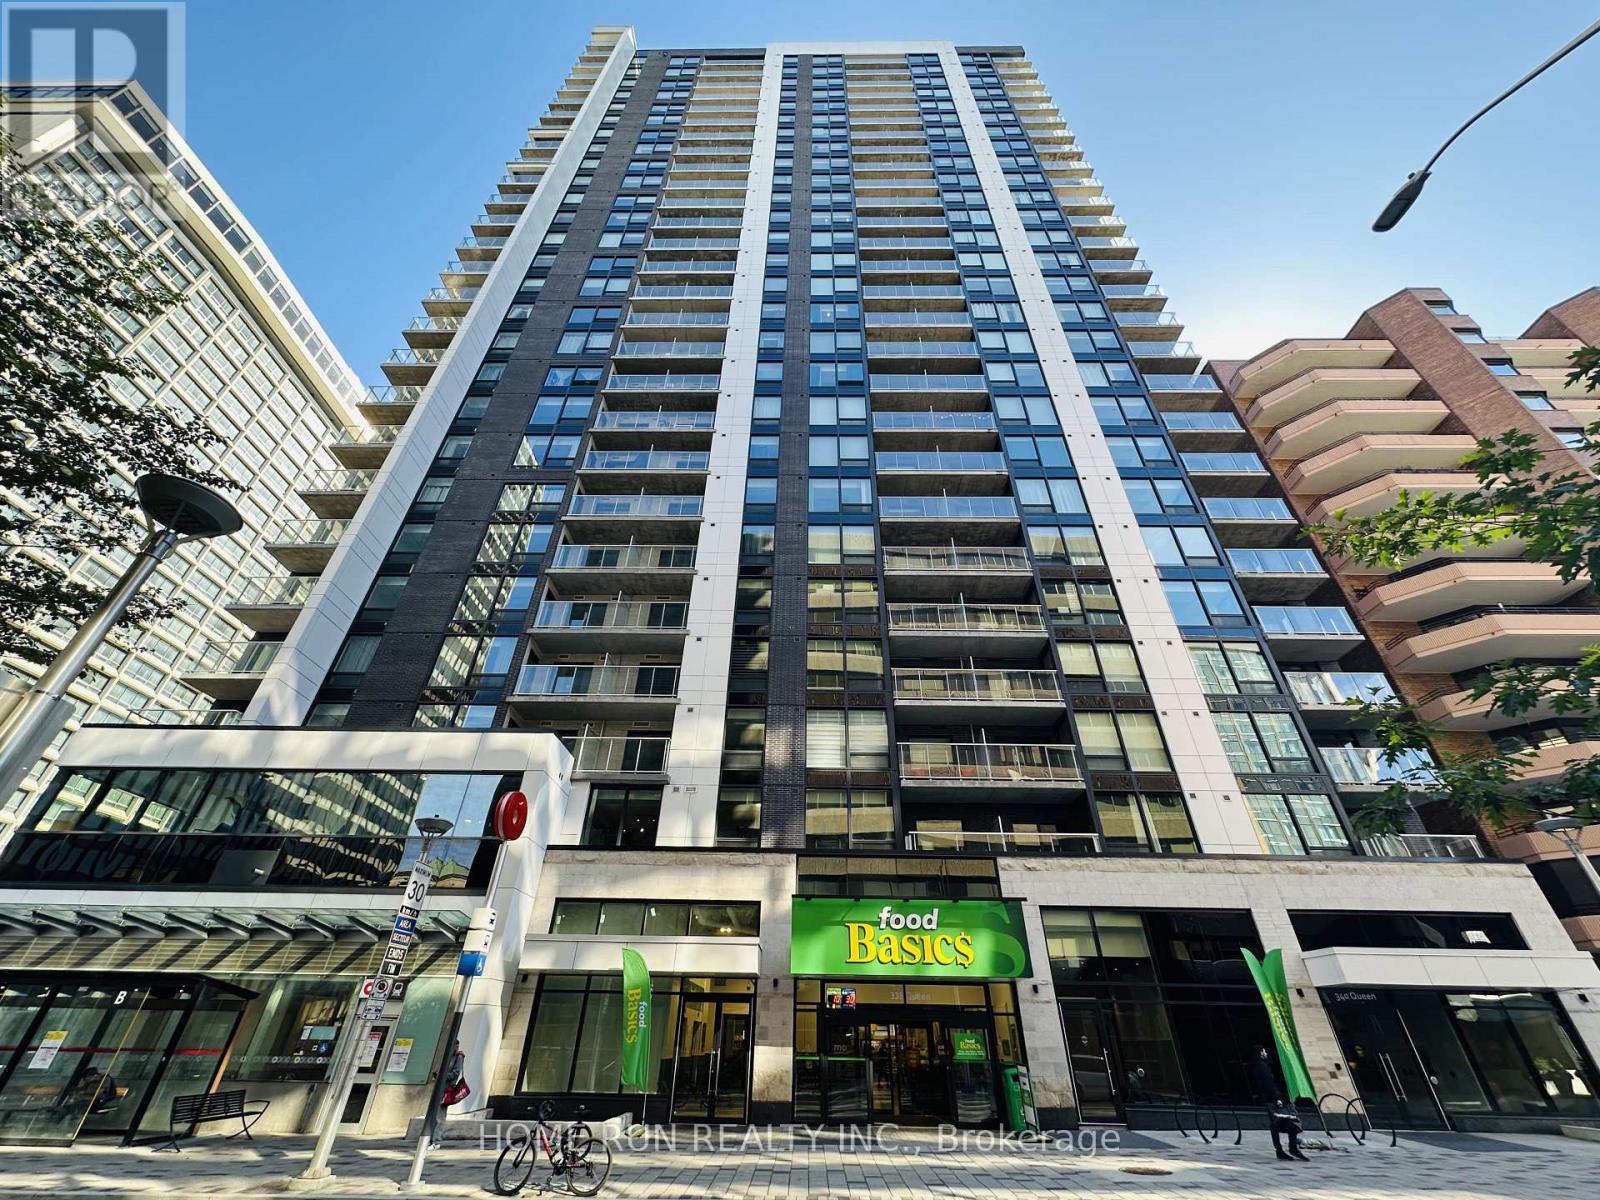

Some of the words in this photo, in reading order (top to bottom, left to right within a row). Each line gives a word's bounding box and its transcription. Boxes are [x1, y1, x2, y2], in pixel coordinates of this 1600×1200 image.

[407, 881, 425, 902] 30
[401, 906, 417, 917] km/h
[879, 906, 939, 930] food
[399, 920, 411, 929] AREA
[392, 933, 411, 944] SECTEUR
[388, 947, 404, 960] ENDS
[387, 963, 397, 974] FIN
[113, 991, 127, 1005] B
[1334, 992, 1349, 1001] 340
[1349, 991, 1377, 1000] Queen
[638, 1001, 648, 1027] food
